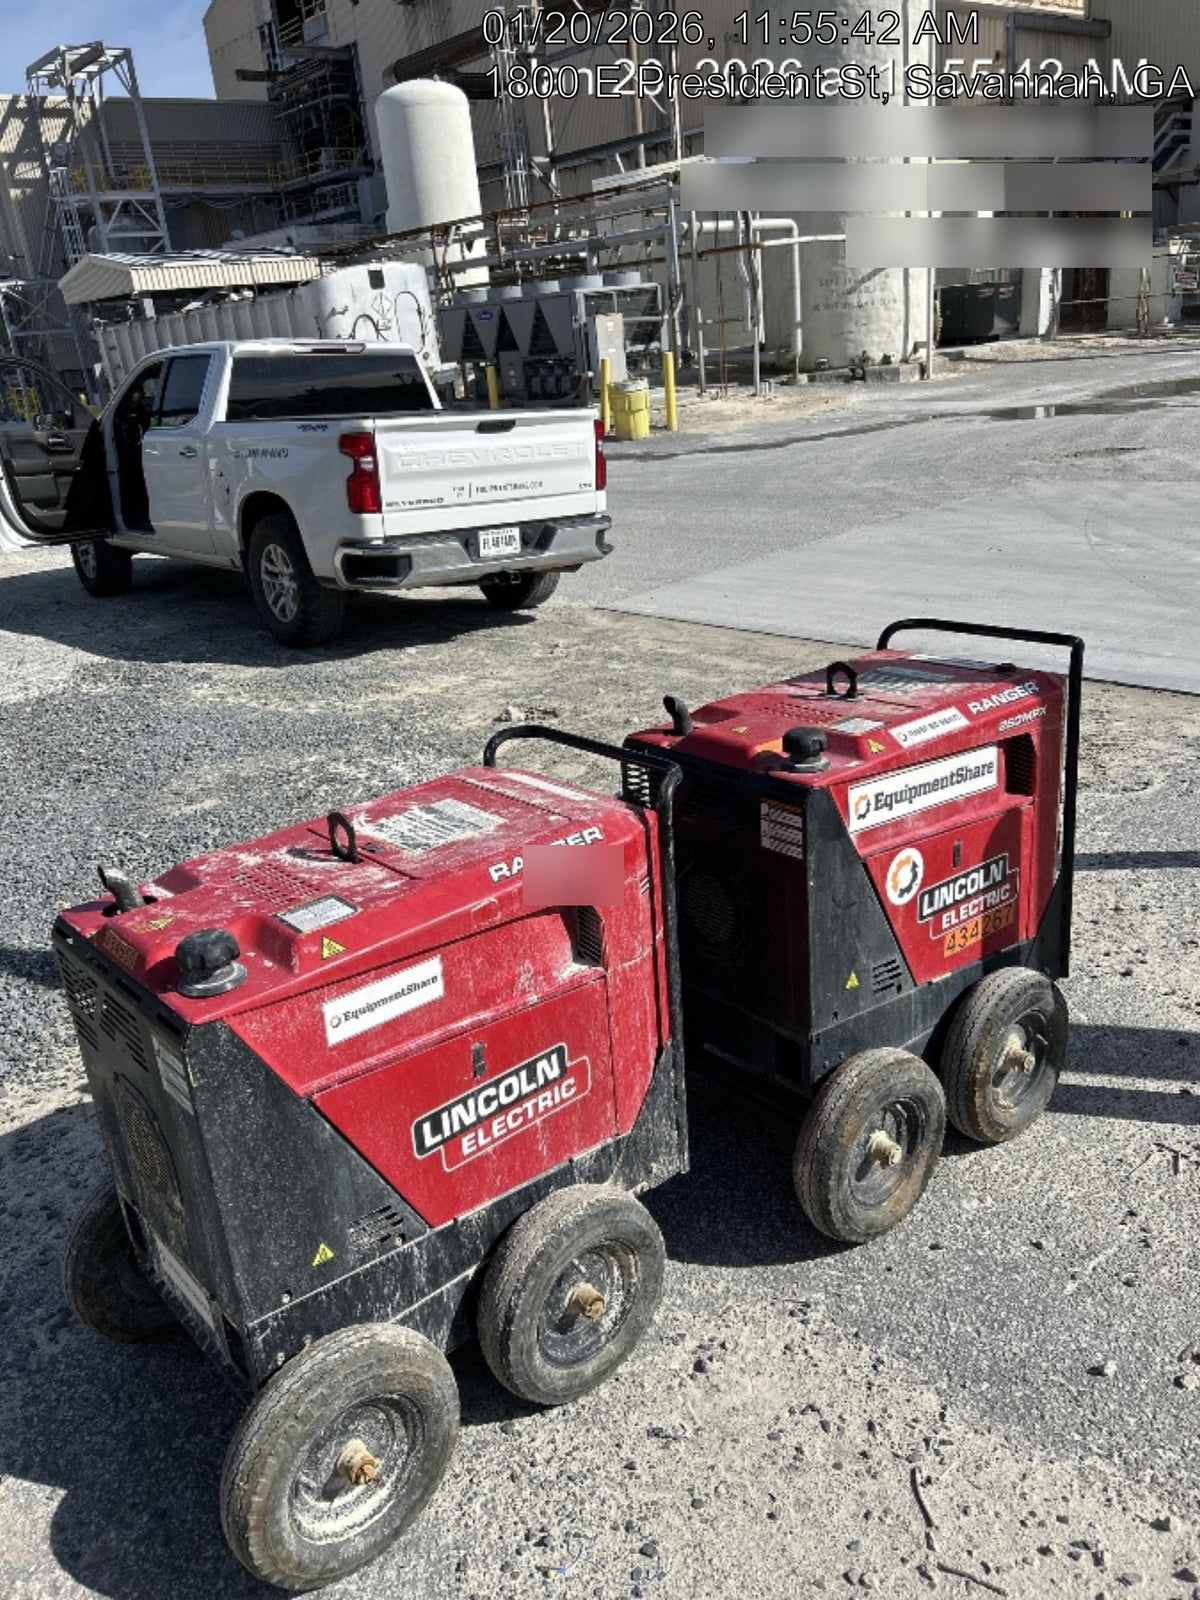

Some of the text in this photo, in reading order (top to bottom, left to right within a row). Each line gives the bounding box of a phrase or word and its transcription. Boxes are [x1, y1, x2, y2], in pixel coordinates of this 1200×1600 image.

[967, 679, 1040, 715] RANGER
[873, 760, 995, 812] EquipmentShare
[488, 826, 604, 883] RAER
[922, 859, 1005, 917] LINCOLN
[941, 883, 1011, 930] ELECTRIC
[342, 974, 439, 1023] EquipmentShare
[422, 1051, 562, 1149] LINCOLN
[461, 1077, 577, 1156] ELECTRIC
